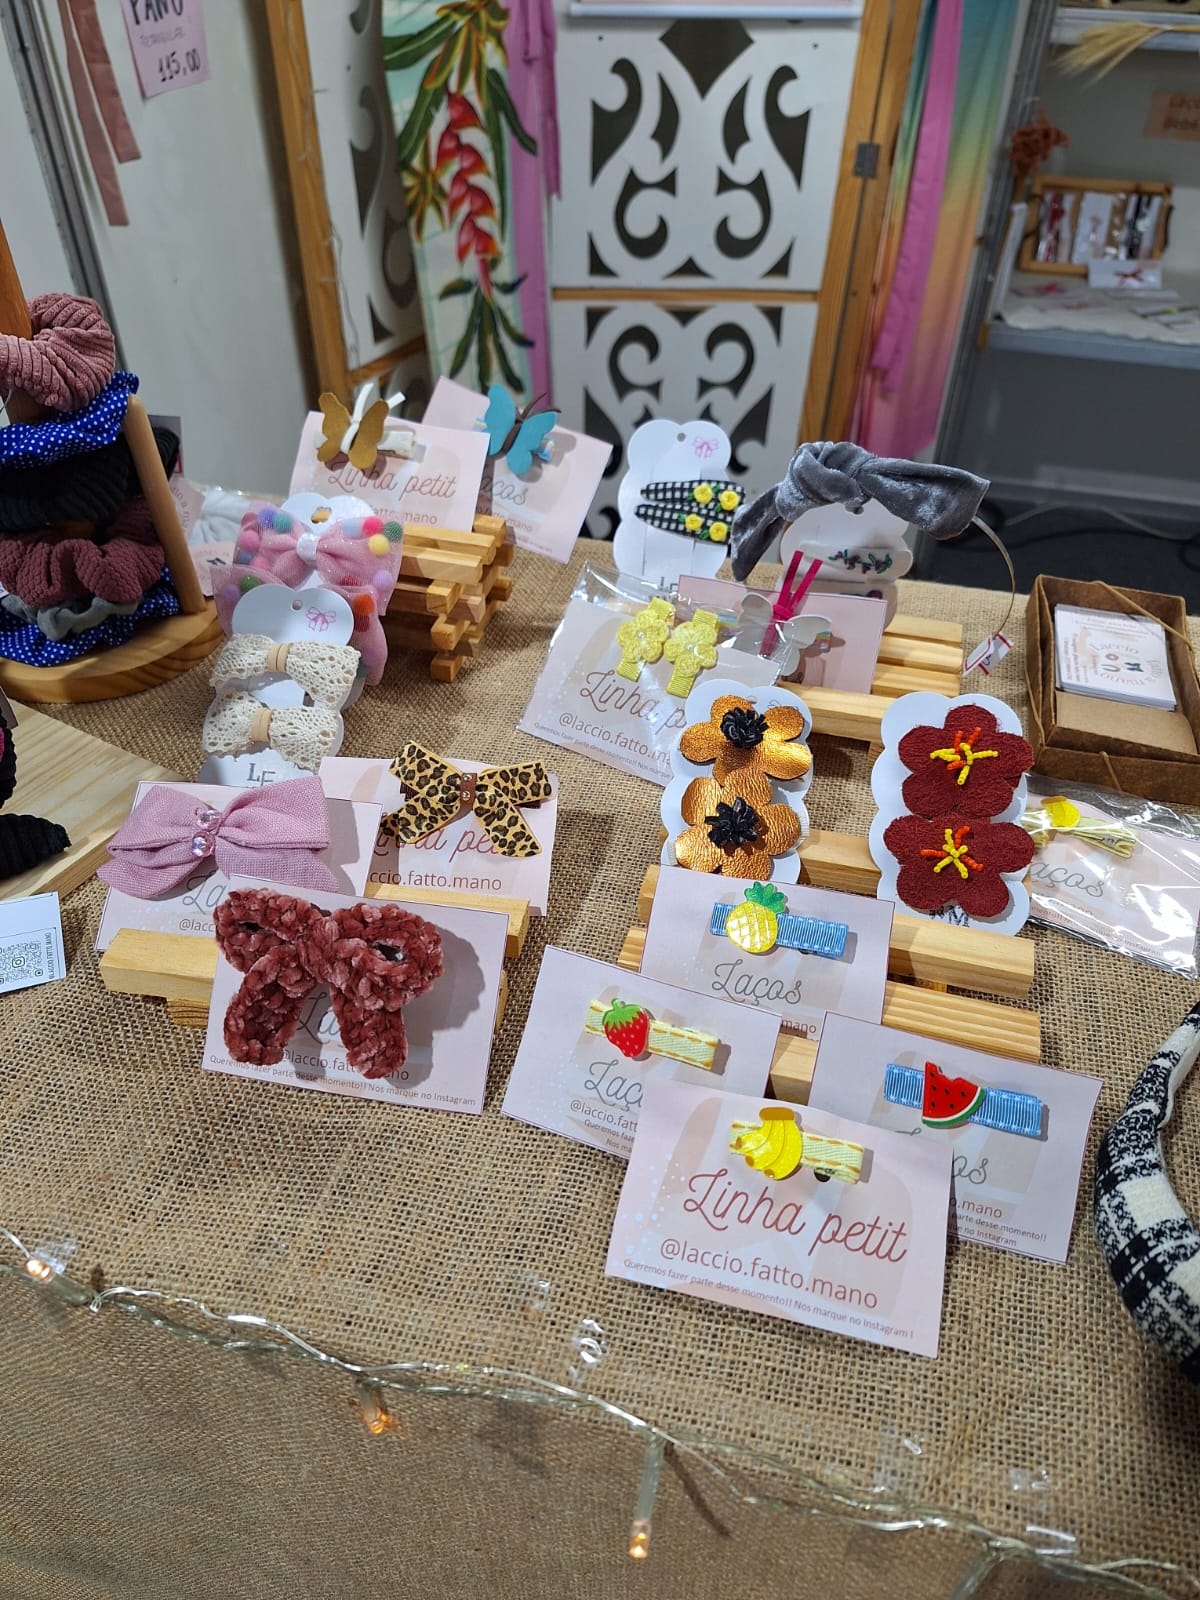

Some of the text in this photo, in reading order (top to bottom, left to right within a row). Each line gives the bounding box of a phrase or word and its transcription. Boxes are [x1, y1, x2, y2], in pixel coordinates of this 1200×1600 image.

[399, 474, 457, 501] petit
[579, 669, 659, 720] Linha
[370, 869, 502, 890] ccio.fatto.mano
[1031, 862, 1104, 898] aços
[711, 958, 802, 1006] Laços
[272, 1067, 294, 1078] parte
[295, 1070, 318, 1081] desse
[368, 1083, 384, 1093] Nos
[386, 1086, 419, 1098] marque
[421, 1091, 432, 1100] no
[433, 1092, 476, 1106] Instagram
[584, 1059, 643, 1112] Laç
[570, 1099, 639, 1132] @laccio.fatt
[584, 1119, 620, 1137] Queremos
[606, 1138, 620, 1149] Nos
[683, 1168, 908, 1263] Linha petit
[975, 1218, 999, 1230] desse
[964, 1227, 975, 1236] no
[976, 1230, 1017, 1247] Instagram
[660, 1238, 878, 1309] @laccio.fatto.mano
[623, 1259, 666, 1277] Queremos
[667, 1269, 688, 1281] fazer
[690, 1275, 714, 1289] parte
[715, 1281, 740, 1295] desse
[794, 1300, 811, 1313] Nos
[812, 1306, 847, 1323] marque
[849, 1315, 861, 1326] no
[863, 1319, 909, 1336] Instagram
